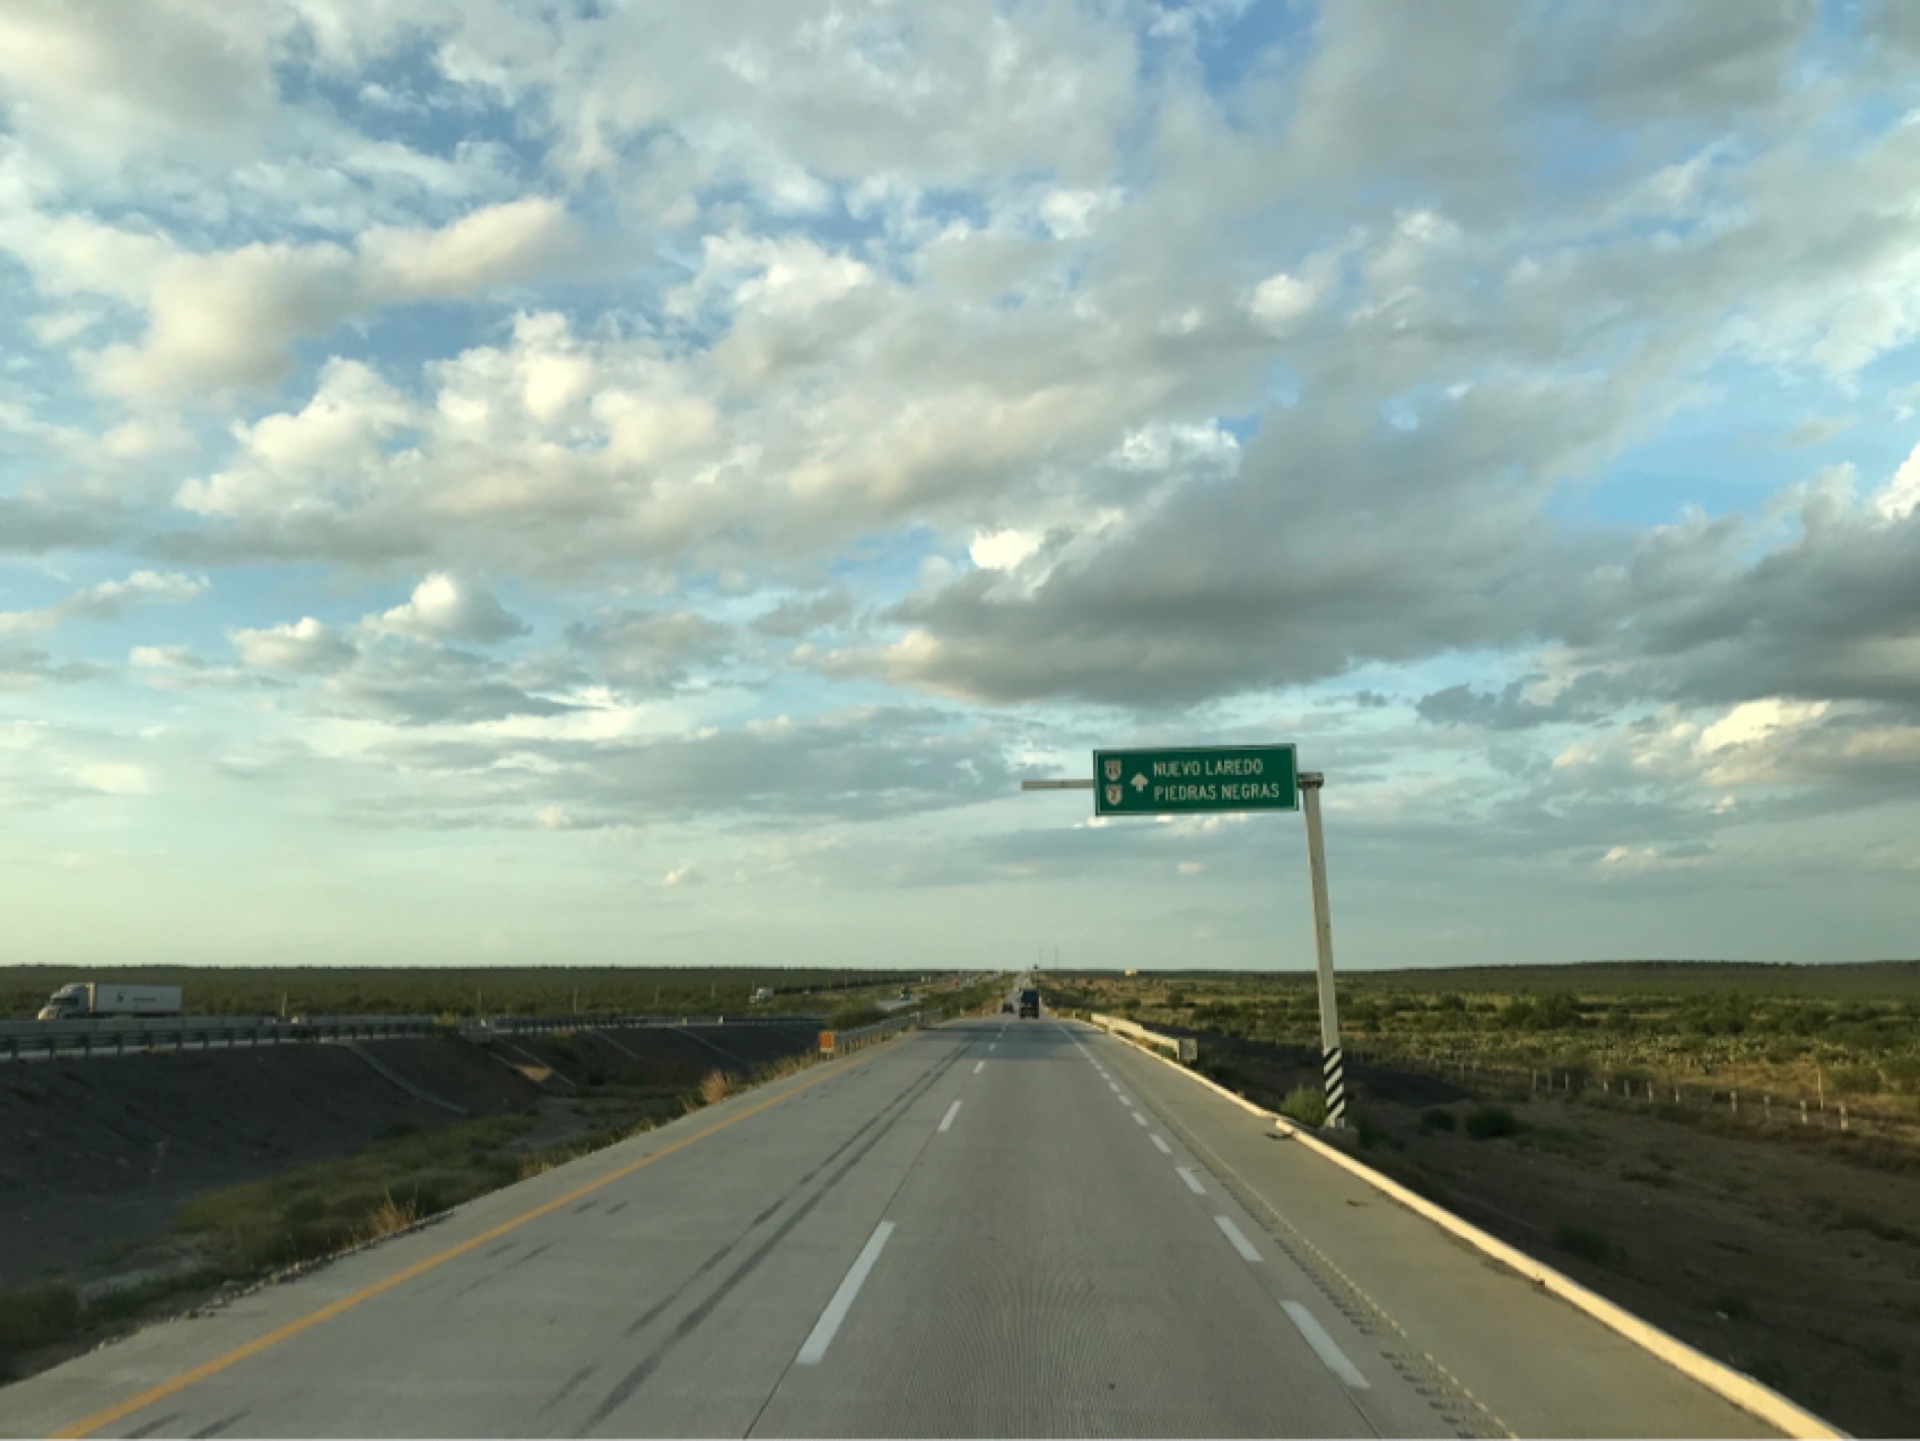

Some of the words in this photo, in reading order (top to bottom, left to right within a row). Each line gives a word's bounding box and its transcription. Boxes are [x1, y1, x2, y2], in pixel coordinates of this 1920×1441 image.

[1154, 760, 1200, 777] NUEVO
[1205, 758, 1263, 775] LAREDO
[1154, 784, 1216, 801] PIEDRAS
[1222, 783, 1280, 799] NEGRAS
